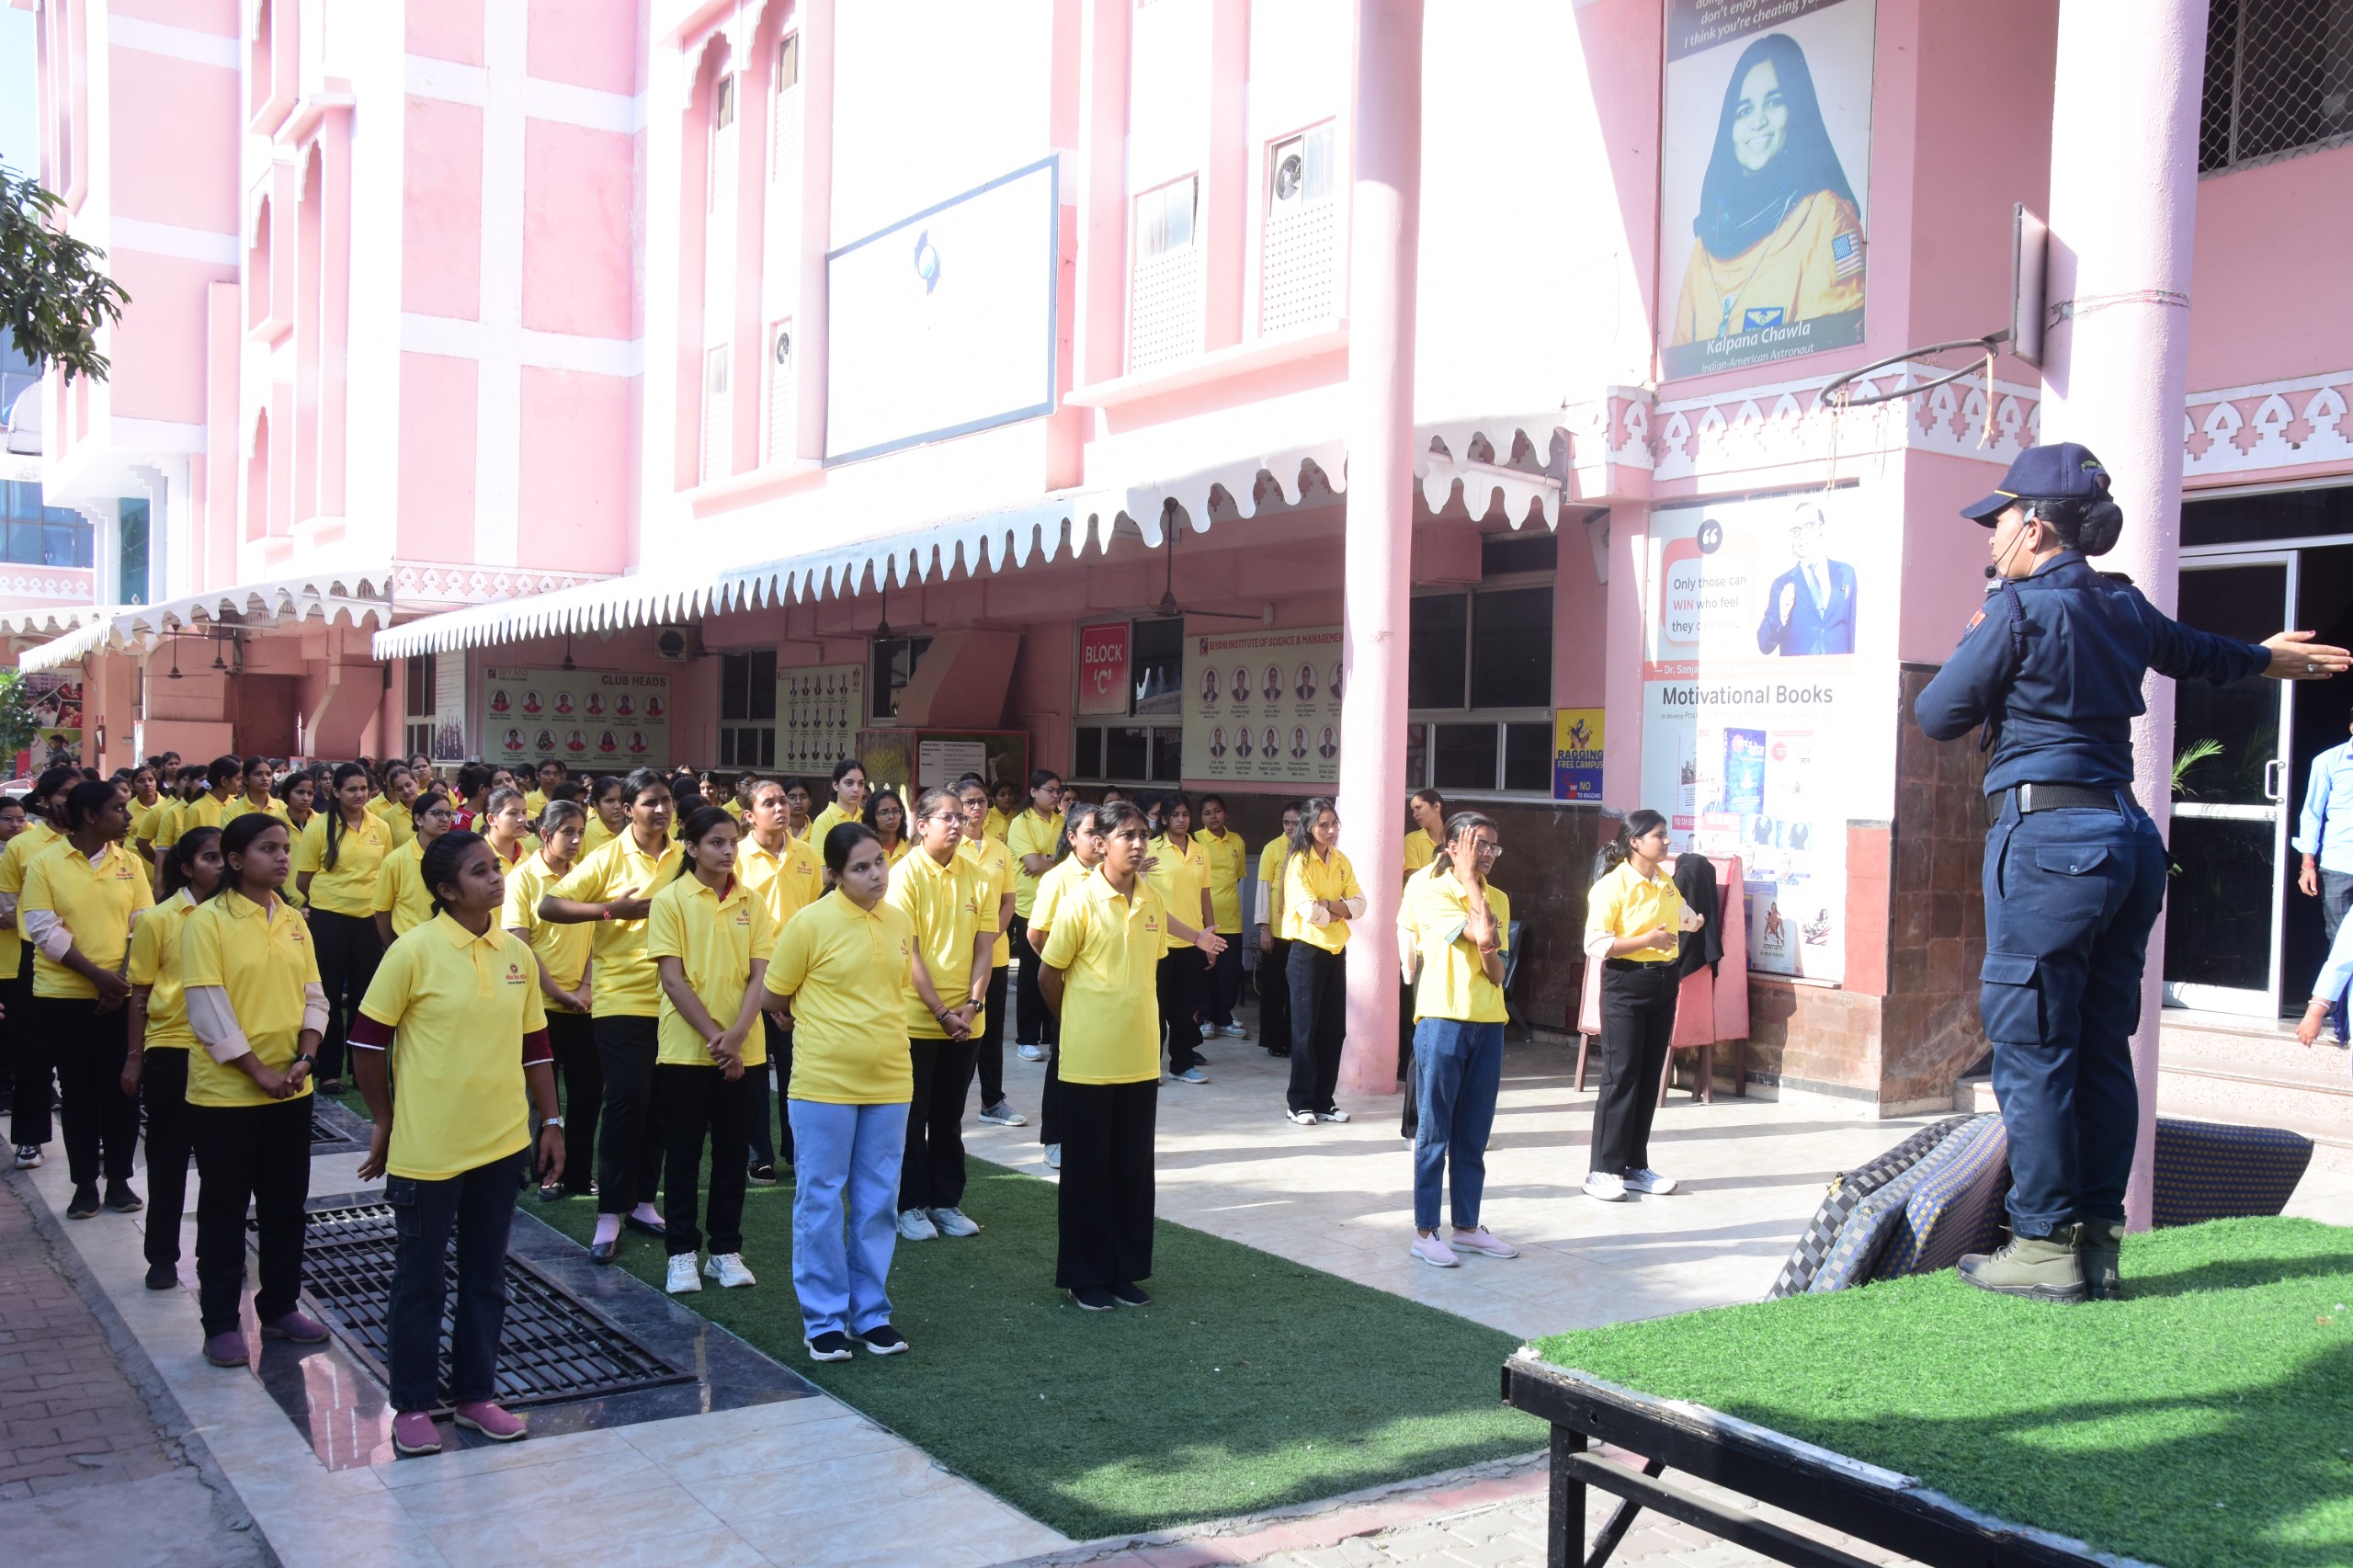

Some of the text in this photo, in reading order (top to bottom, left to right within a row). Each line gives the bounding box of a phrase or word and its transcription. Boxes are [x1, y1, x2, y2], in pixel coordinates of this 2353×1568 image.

[1700, 0, 1758, 25] don't enjoy
[1684, 37, 1688, 49] I
[1690, 27, 1716, 47] think
[1717, 17, 1751, 40] you're
[1752, 0, 1800, 24] cheating
[1706, 321, 1811, 356] Kalpana Chawla
[1701, 343, 1815, 373] Indian-American Astronaut
[1673, 576, 1747, 592] Only those can
[1673, 596, 1739, 611] WIN who feel
[1671, 620, 1694, 634] they
[1209, 631, 1344, 651] BIYANI INSTITUTE OF SCIENCE & MANAGEMEN
[1086, 643, 1123, 663] BLOCK
[498, 668, 529, 677] BIYANI
[1664, 665, 1676, 675] Dr.
[1677, 665, 1699, 676] Sanja
[602, 675, 666, 687] CLUB HEADS
[1662, 684, 1834, 706] Motivational Books
[1557, 749, 1604, 760] RAGGING
[1557, 760, 1604, 769] FREE CAMPUS
[1579, 781, 1591, 791] NO
